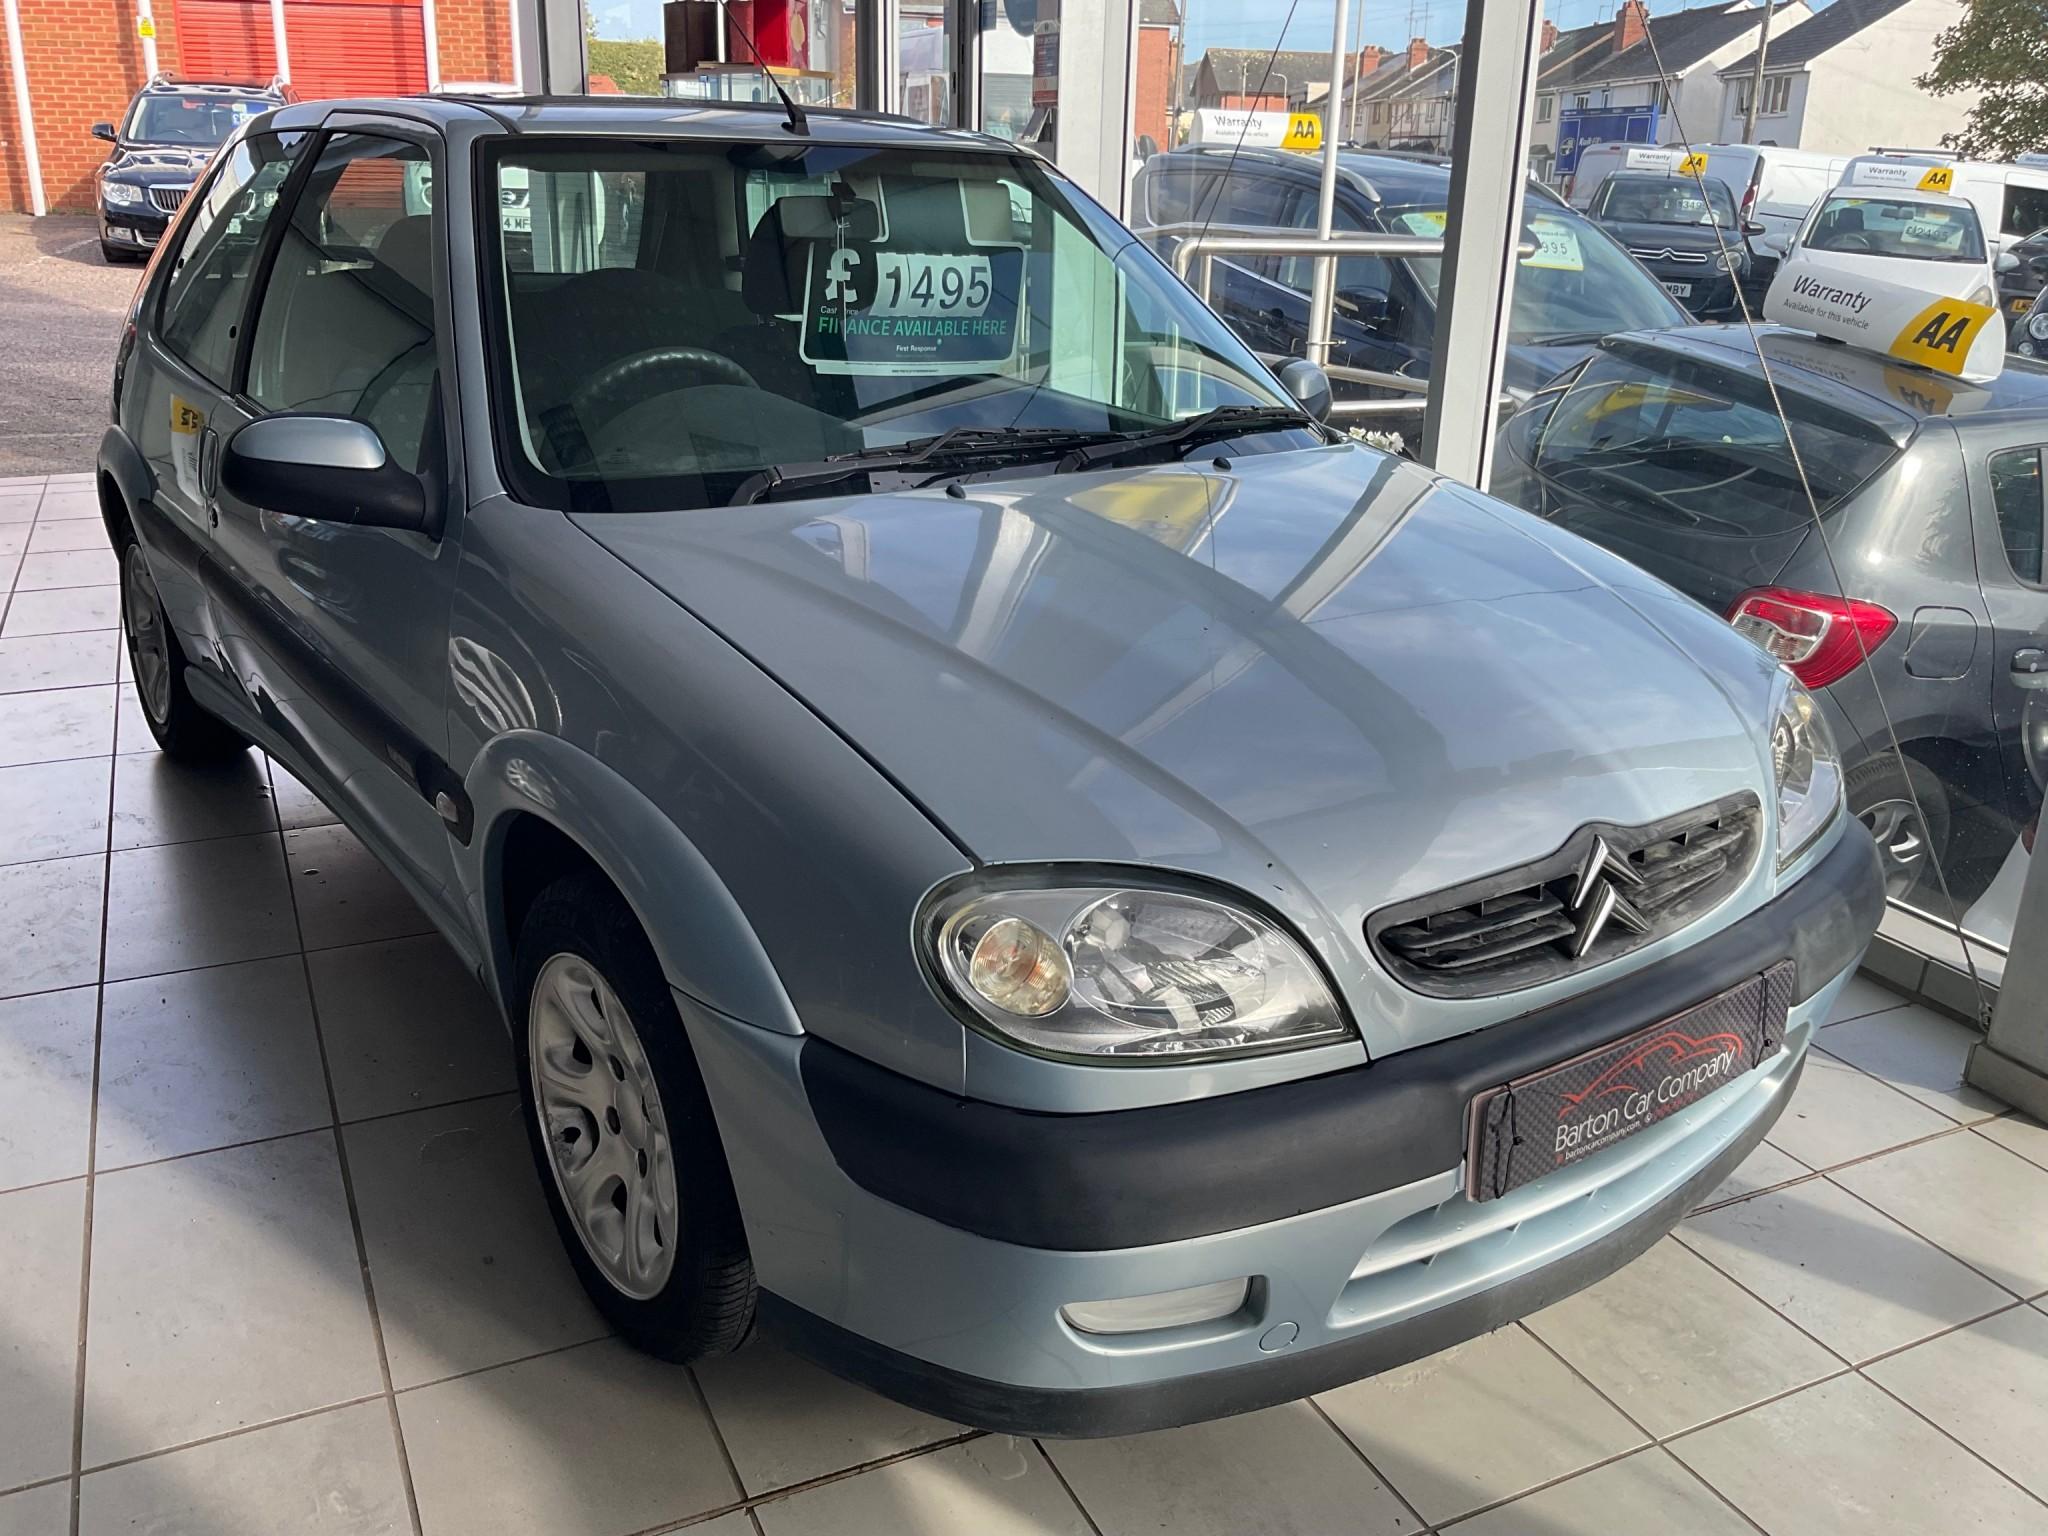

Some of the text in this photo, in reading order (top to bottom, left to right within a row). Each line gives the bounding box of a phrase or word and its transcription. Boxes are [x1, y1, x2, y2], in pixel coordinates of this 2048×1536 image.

[1214, 115, 1262, 130] Warranty
[1294, 120, 1315, 139] AA
[1638, 153, 1671, 161] Warranty
[1868, 166, 1908, 177] Warranty
[1928, 172, 1948, 185] AA
[825, 249, 990, 310] £ 1495
[1793, 274, 1872, 314] Warranty
[1783, 298, 1870, 330] Available for this vehicle
[893, 319, 970, 337] AVAILABLE
[972, 320, 1008, 336] HERE
[1911, 312, 1971, 354] AA
[896, 344, 938, 354] First Response
[1555, 1107, 1619, 1153] Barton
[1623, 1089, 1655, 1119] Car
[1657, 1047, 1736, 1103] Company
[1565, 1119, 1641, 1160] bartoncarcompany.com
